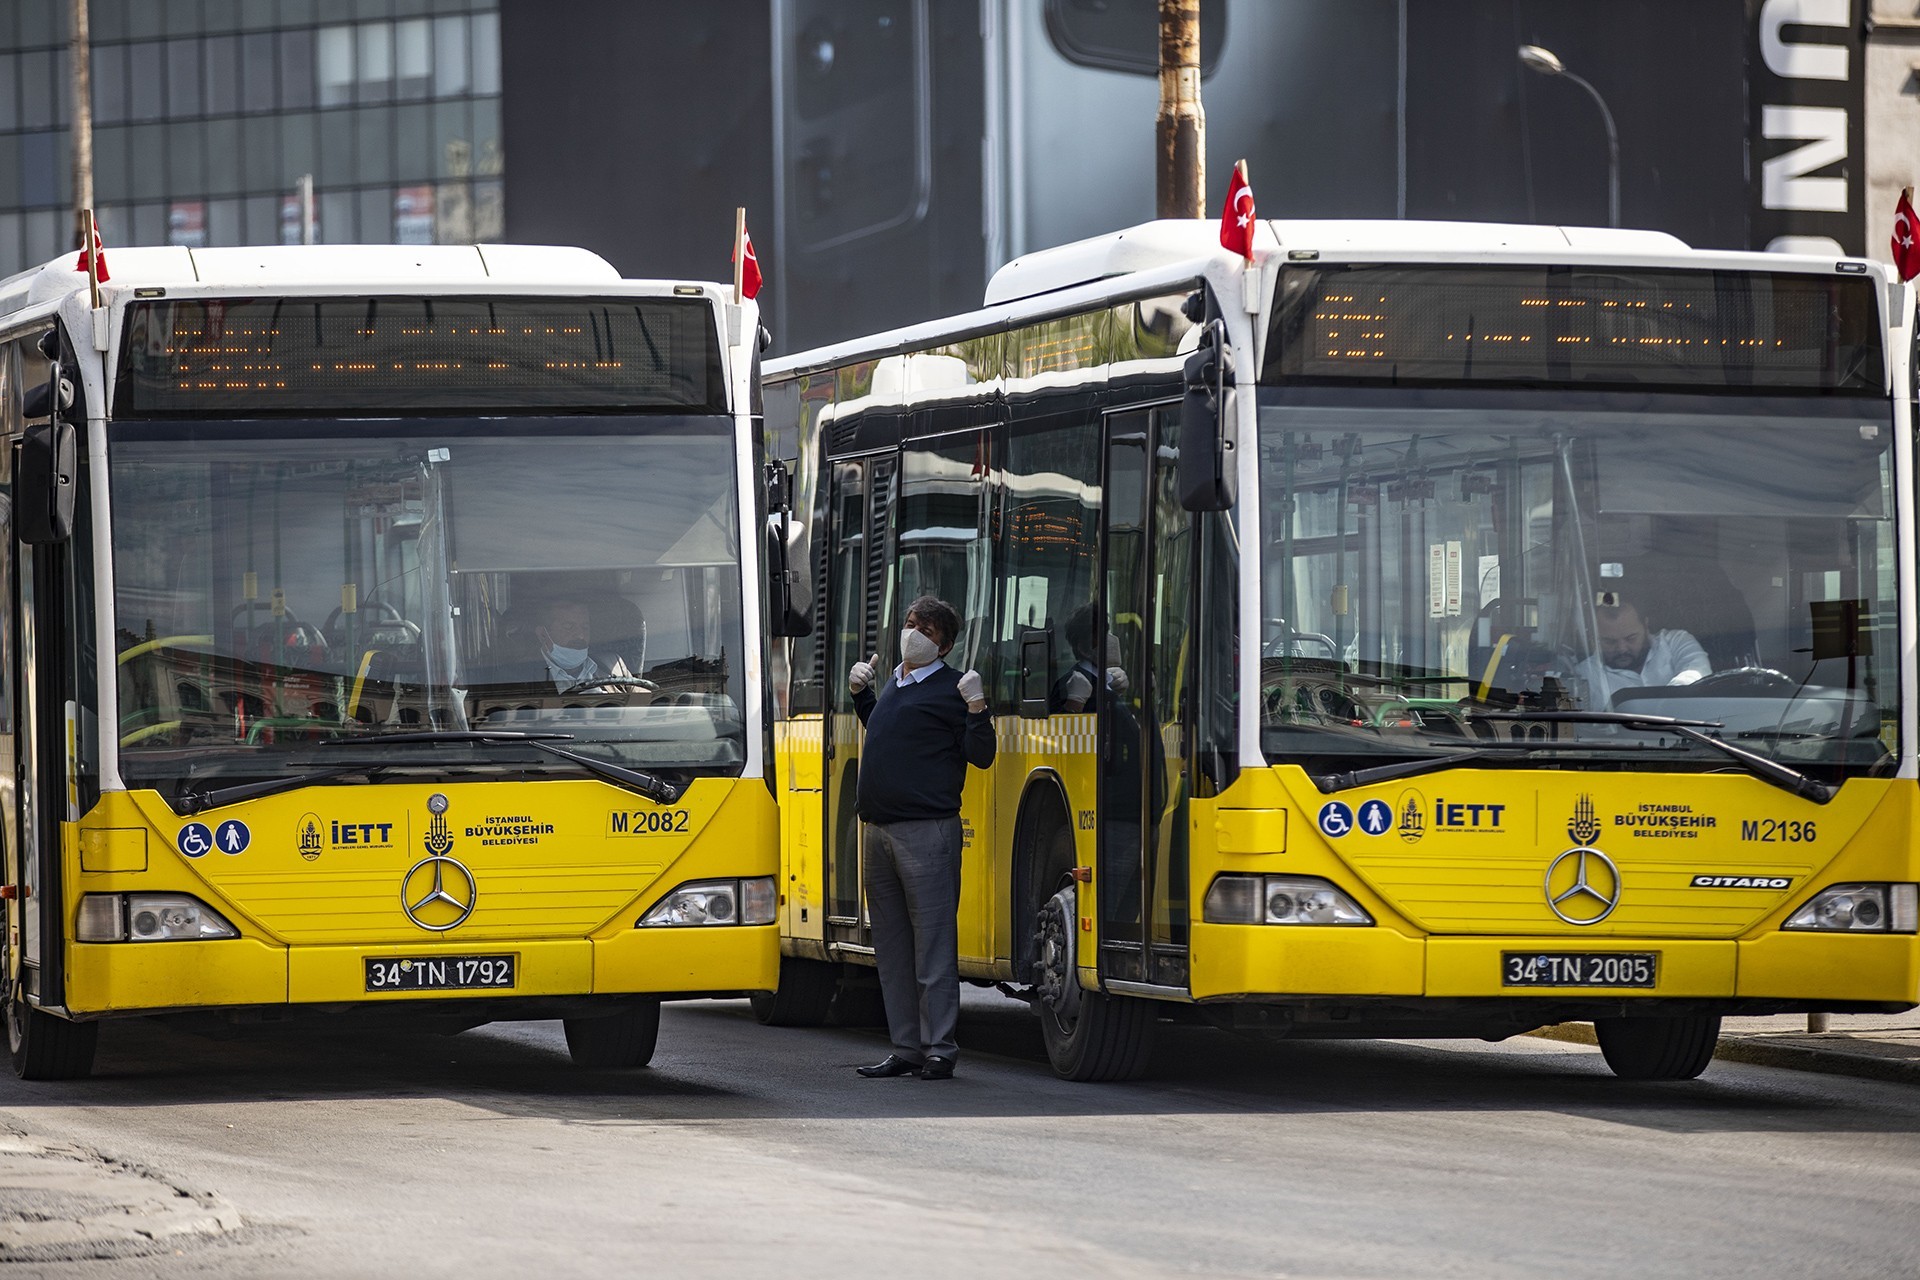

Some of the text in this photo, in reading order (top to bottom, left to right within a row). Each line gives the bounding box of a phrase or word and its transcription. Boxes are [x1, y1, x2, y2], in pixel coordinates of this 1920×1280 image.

[1435, 798, 1506, 827] İETT
[1638, 802, 1693, 813] İSTANBUL
[485, 815, 533, 824] İSTANBUL
[1614, 812, 1716, 829] BÜYÜKŞEHİR
[331, 820, 393, 844] İETT
[465, 822, 555, 838] BÜYÜKŞEHİR
[1741, 818, 1817, 842] M2136
[1693, 876, 1789, 888] CITARO
[371, 960, 509, 987] 34 TN 1792
[1507, 957, 1650, 983] 34 TN 2005
